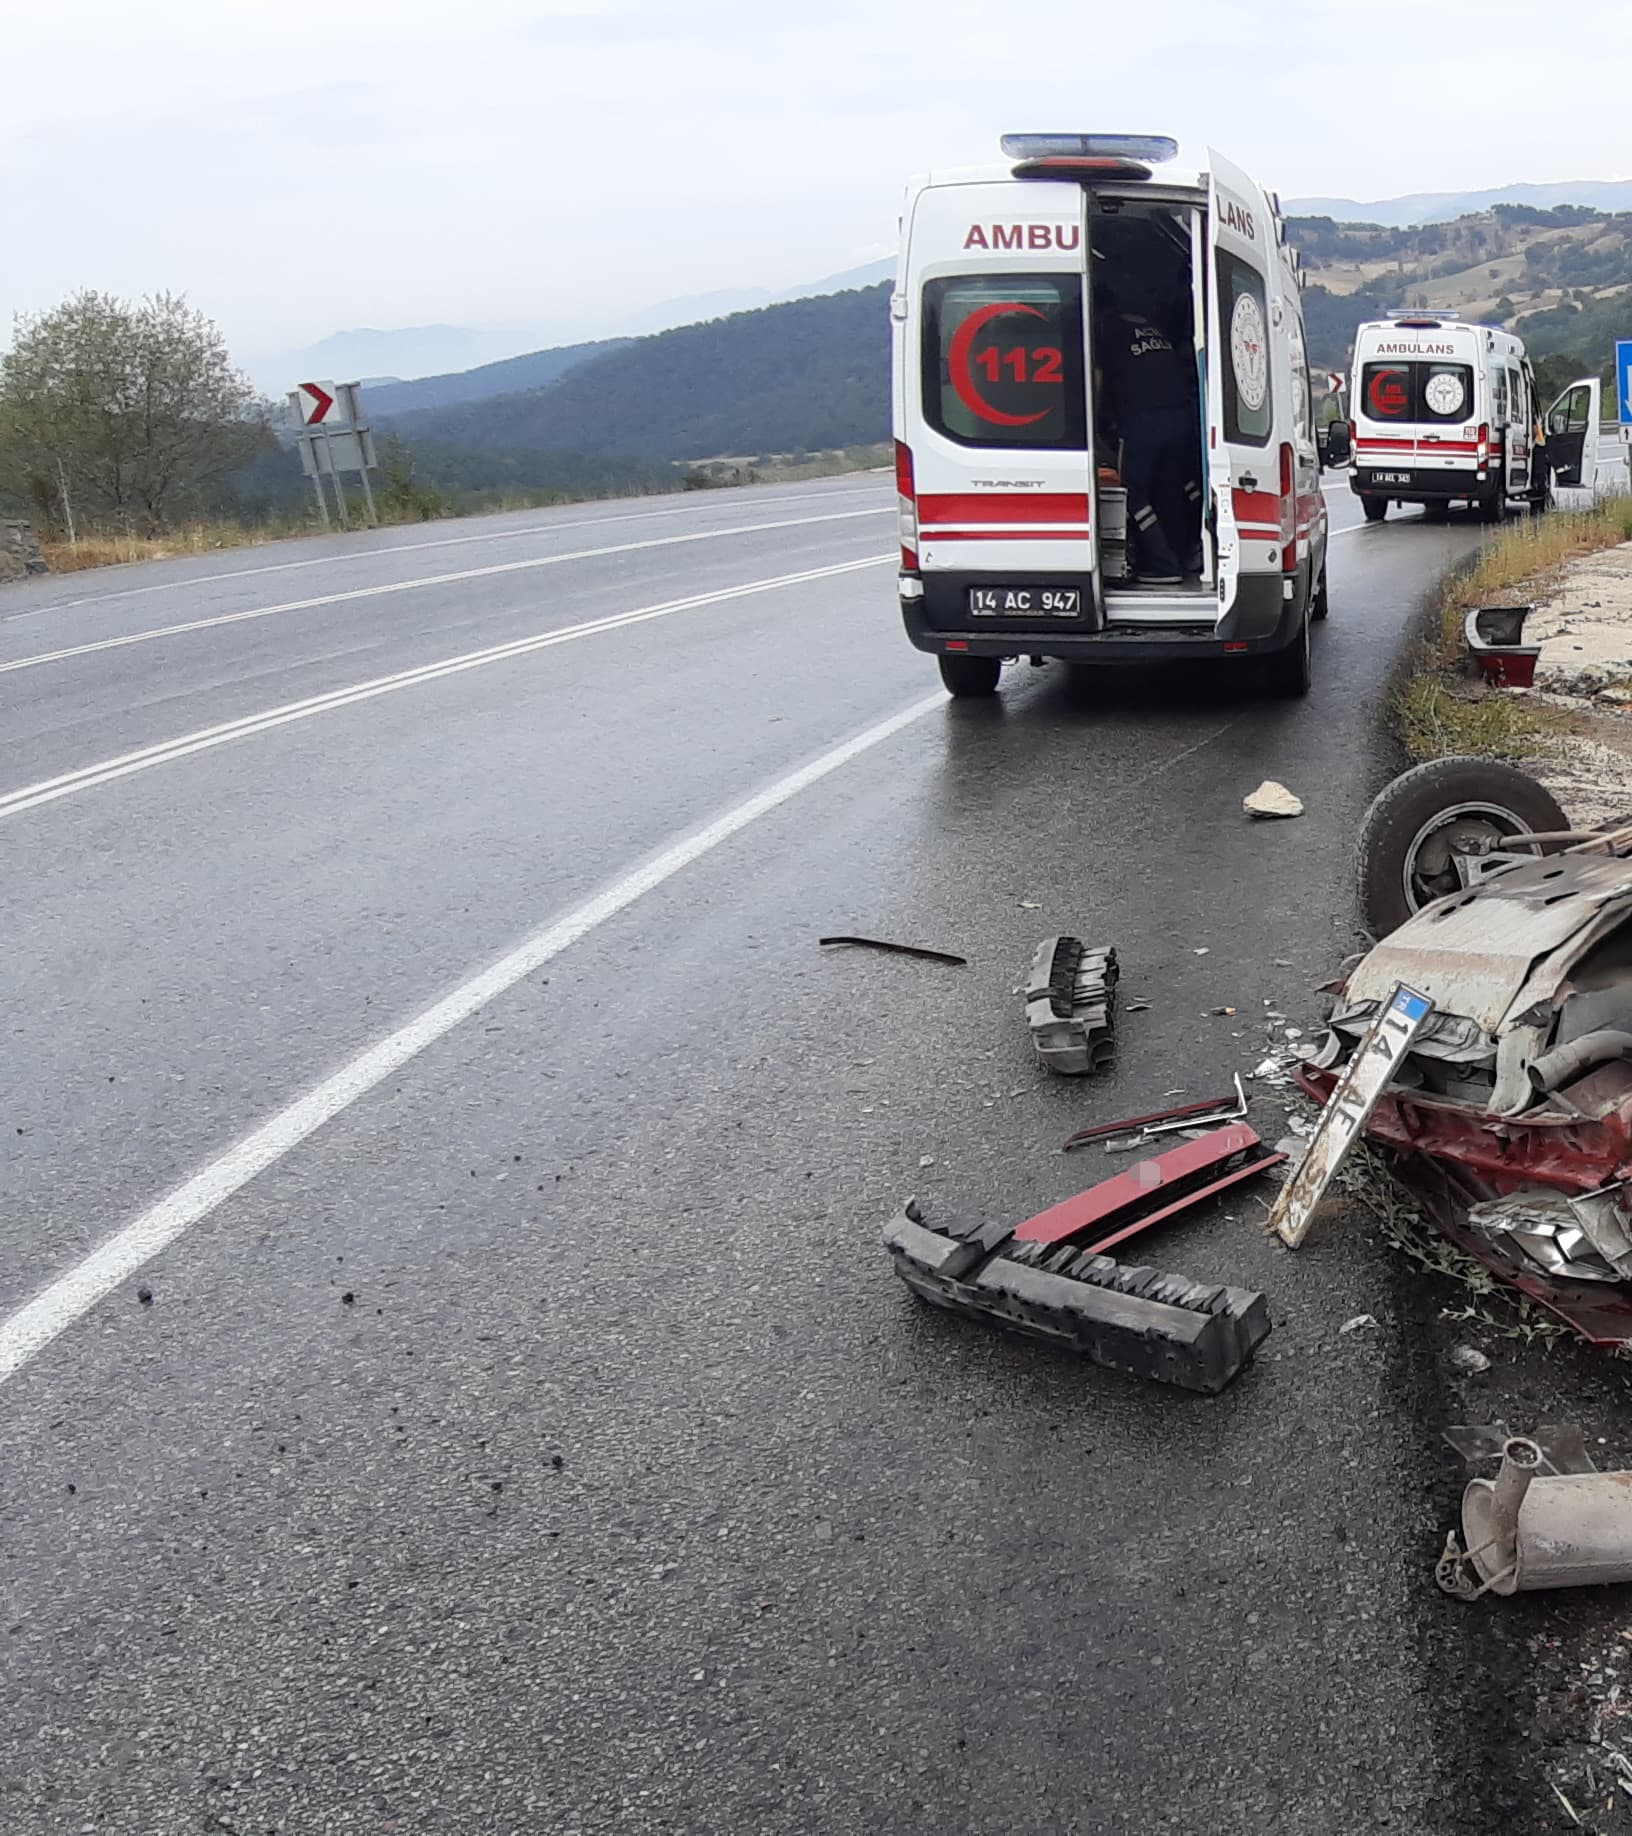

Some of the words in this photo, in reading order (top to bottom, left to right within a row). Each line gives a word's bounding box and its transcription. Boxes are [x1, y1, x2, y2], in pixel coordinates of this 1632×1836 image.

[1215, 194, 1255, 240] LANS
[963, 224, 1080, 251] AMBU
[976, 346, 1065, 383] 112
[1376, 343, 1455, 355] AMBULANS
[976, 591, 997, 609] 14
[1004, 591, 1031, 609] AC
[1041, 592, 1076, 610] 947
[1371, 1017, 1409, 1062] 14
